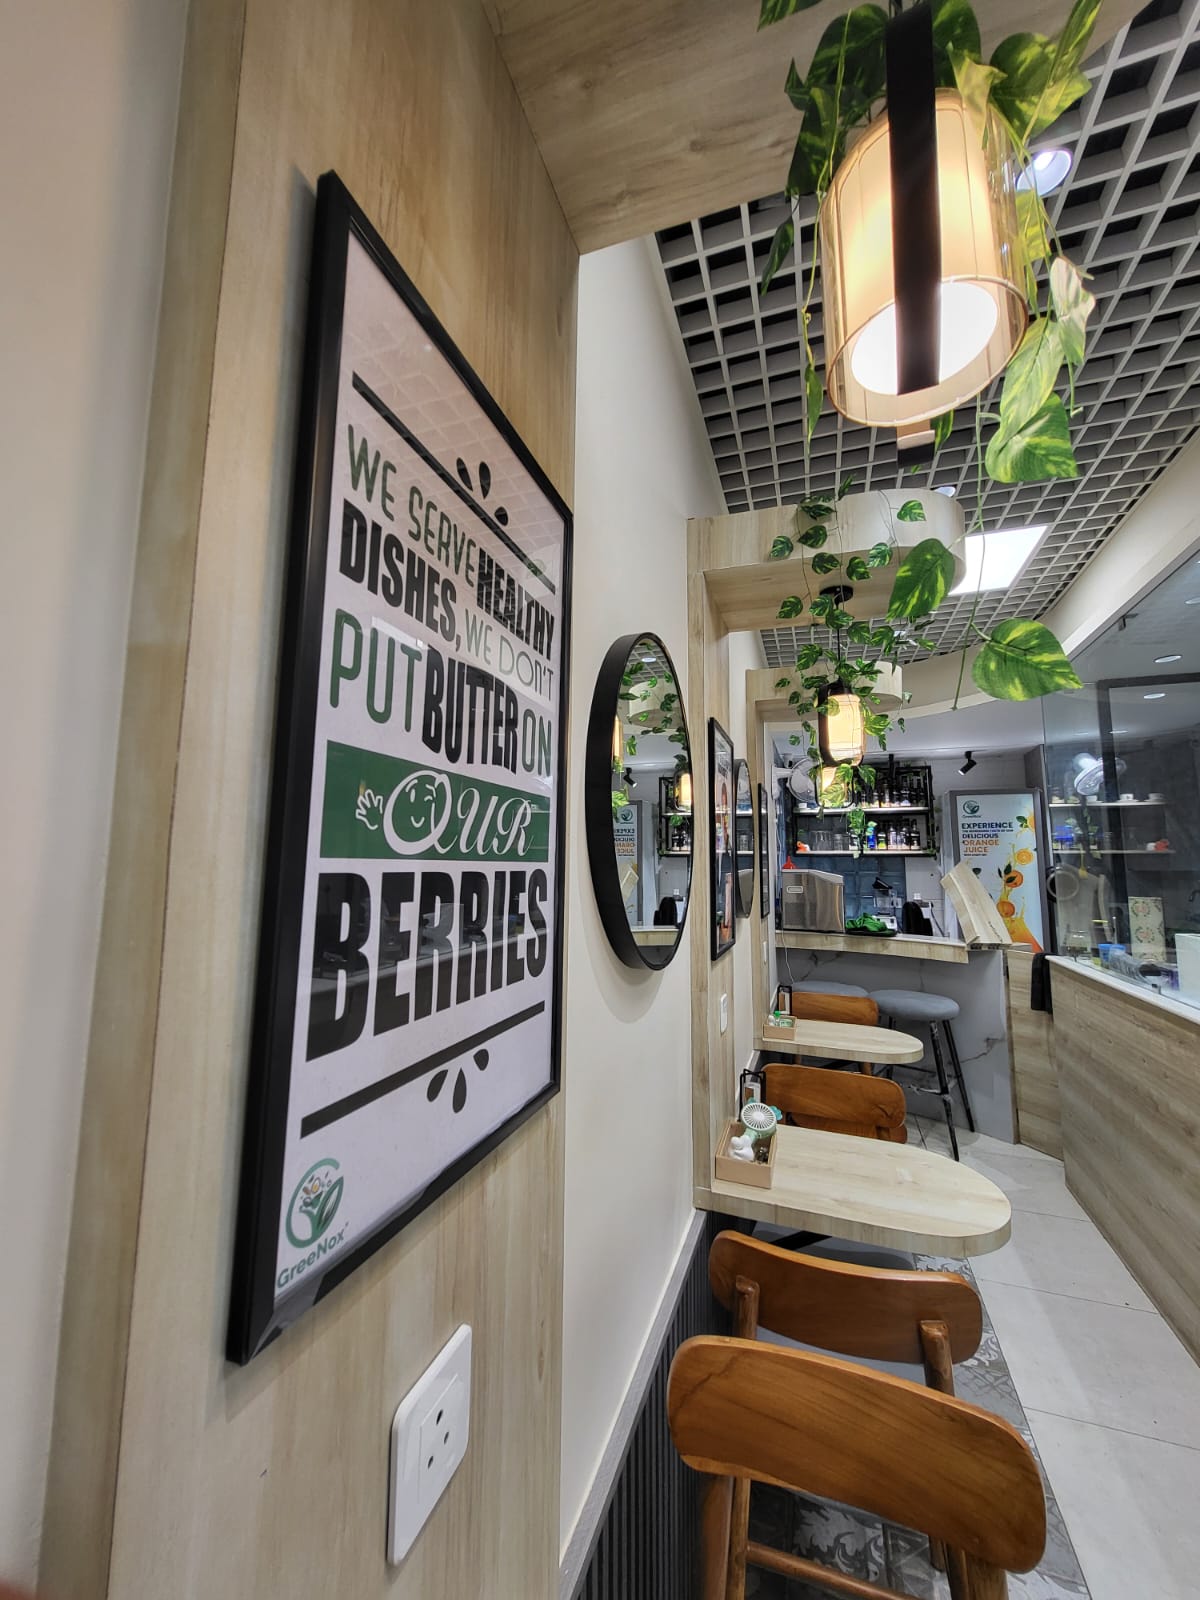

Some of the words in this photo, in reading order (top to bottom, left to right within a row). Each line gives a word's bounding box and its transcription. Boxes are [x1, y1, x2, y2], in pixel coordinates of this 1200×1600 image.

[339, 498, 462, 652] DISHES,
[465, 608, 492, 664] WE
[500, 634, 554, 702] DON'T
[347, 424, 397, 522] WE
[408, 486, 477, 588] SERVE
[476, 547, 555, 662] HEALTHY
[329, 607, 422, 733] PUT
[422, 643, 519, 775] BUTTER
[521, 708, 552, 778] ON
[306, 868, 548, 1063] BERRIES
[277, 1229, 344, 1289] GreeNox
